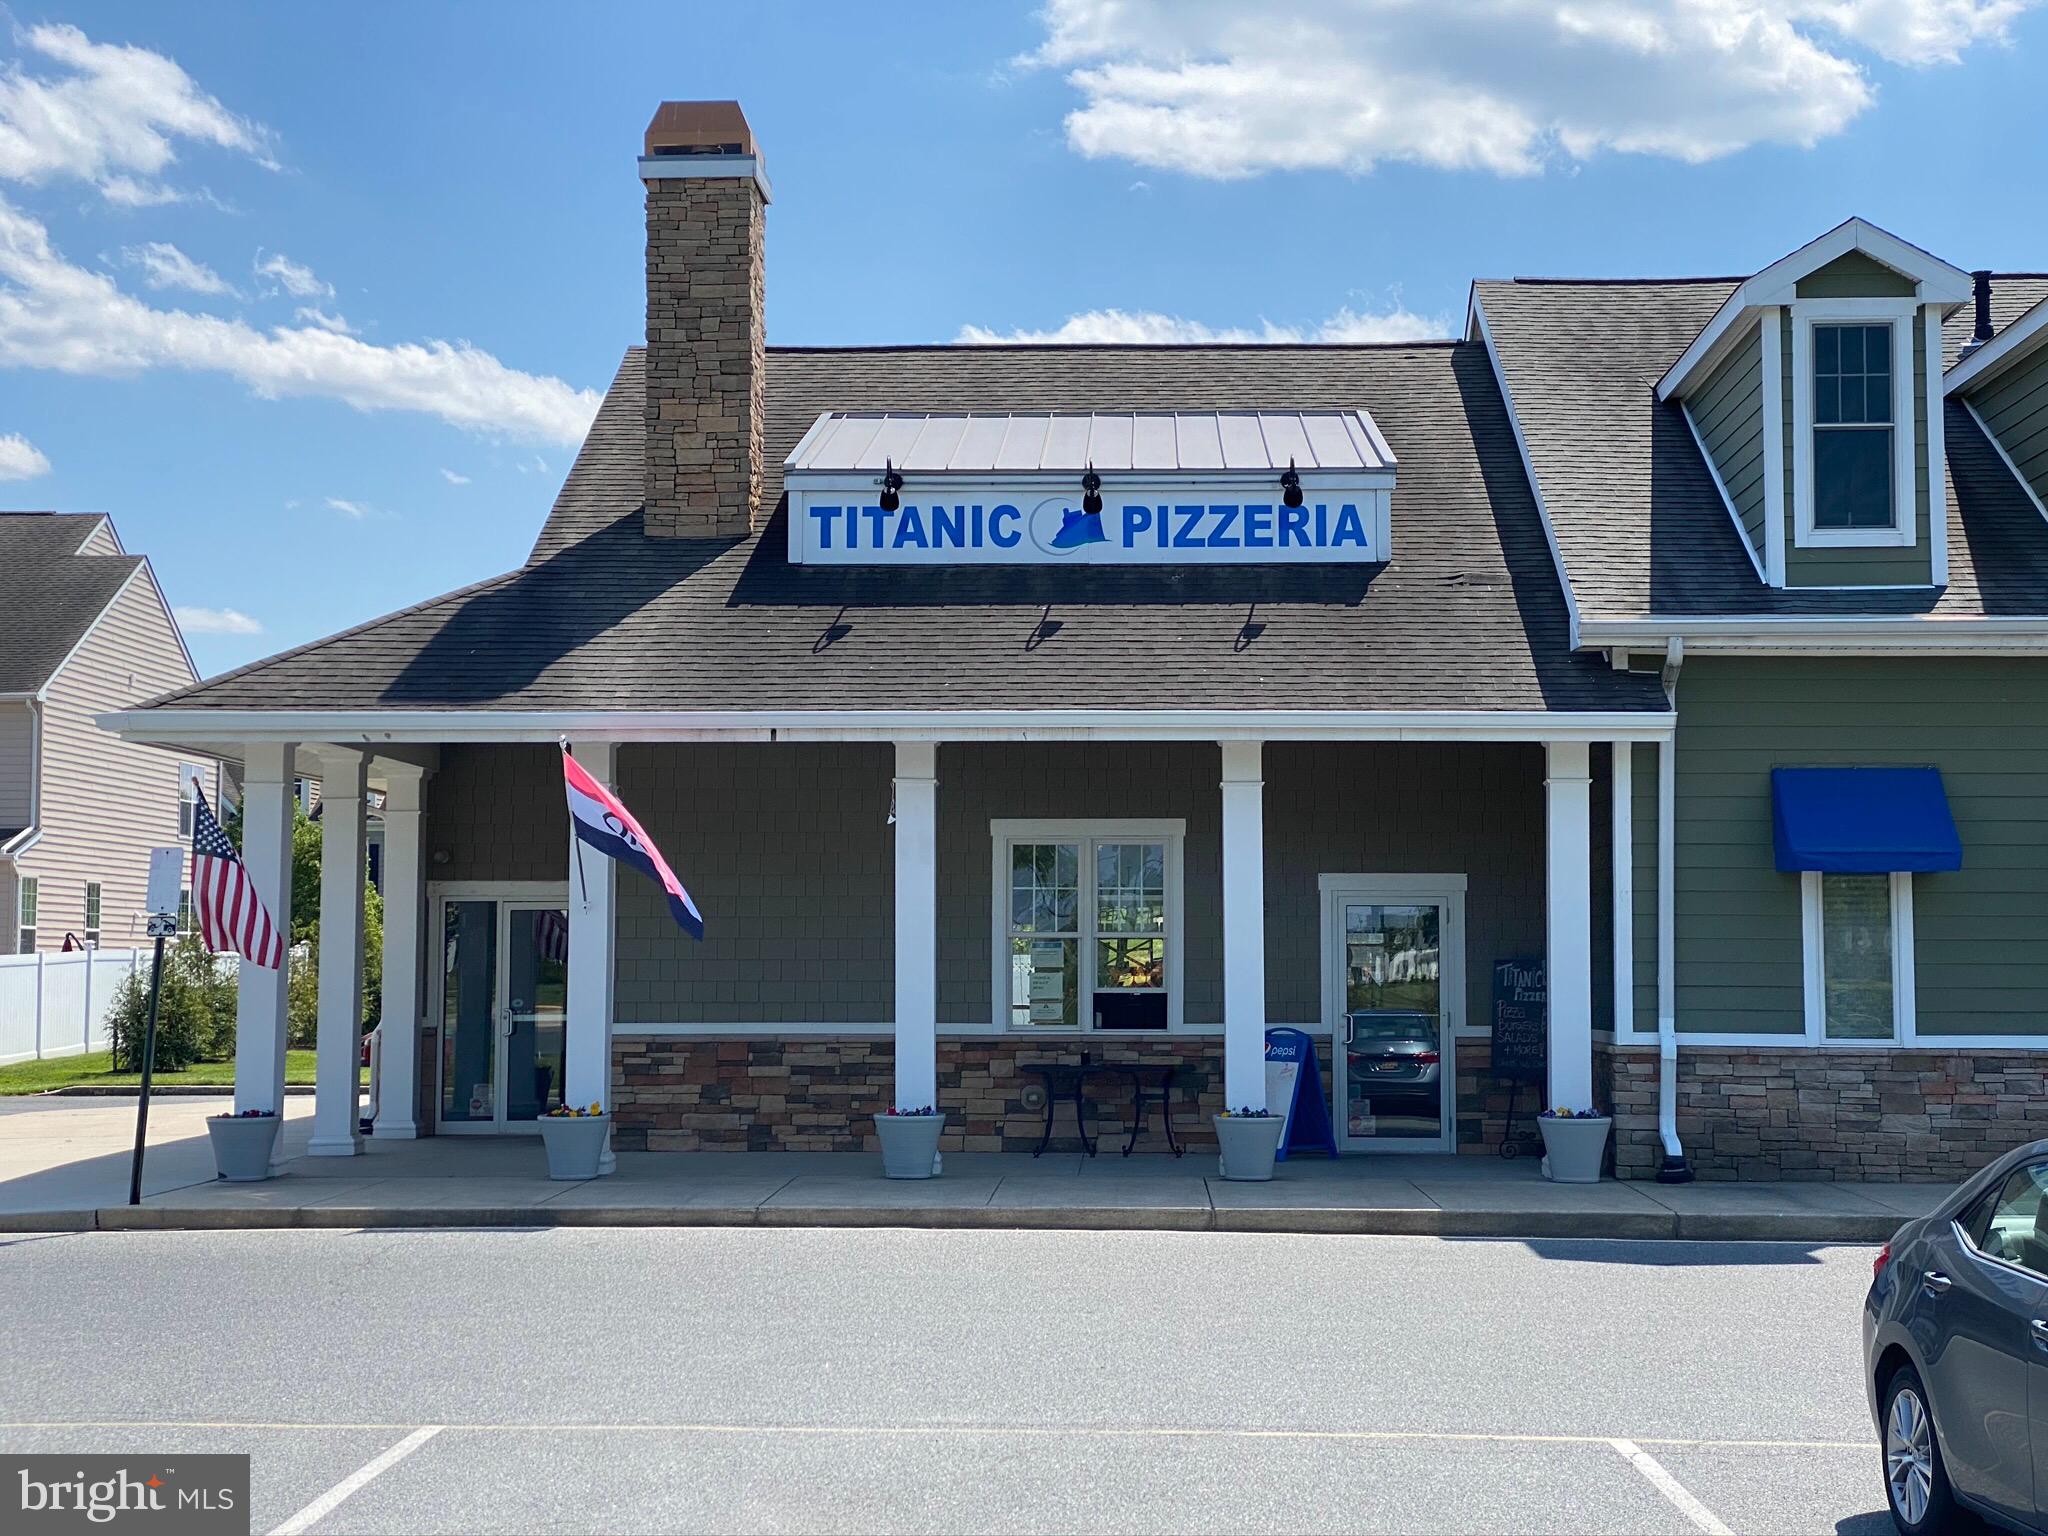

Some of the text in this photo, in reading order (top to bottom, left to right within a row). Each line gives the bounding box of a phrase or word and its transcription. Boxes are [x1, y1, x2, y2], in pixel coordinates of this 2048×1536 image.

[810, 504, 1368, 549] TITANIC PIZZERIA
[1271, 1045, 1296, 1057] pepsi
